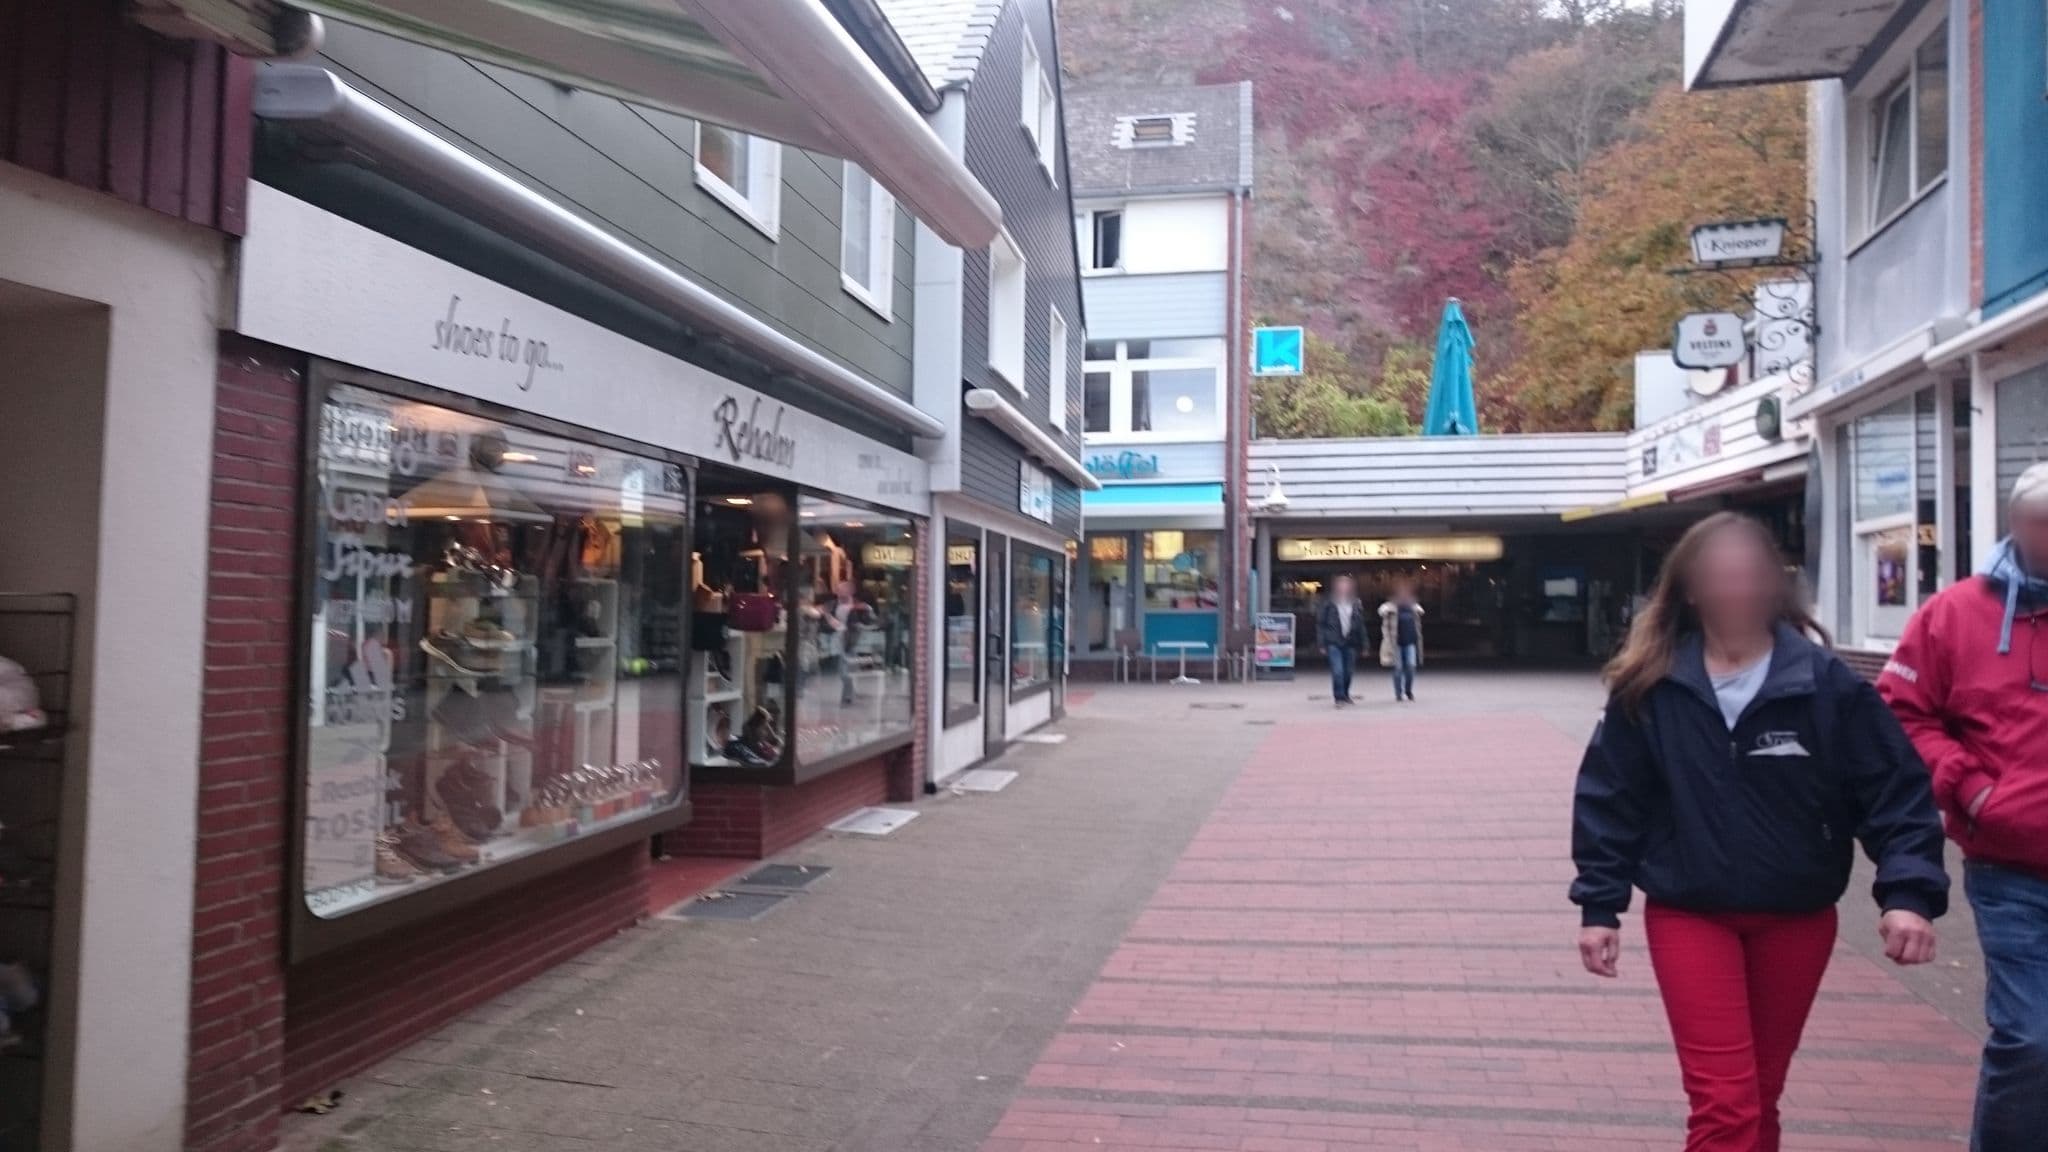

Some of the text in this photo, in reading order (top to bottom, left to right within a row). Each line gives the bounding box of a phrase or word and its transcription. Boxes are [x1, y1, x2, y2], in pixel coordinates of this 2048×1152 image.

[432, 294, 495, 358] shoes
[499, 317, 520, 364] to
[1261, 331, 1299, 368] K
